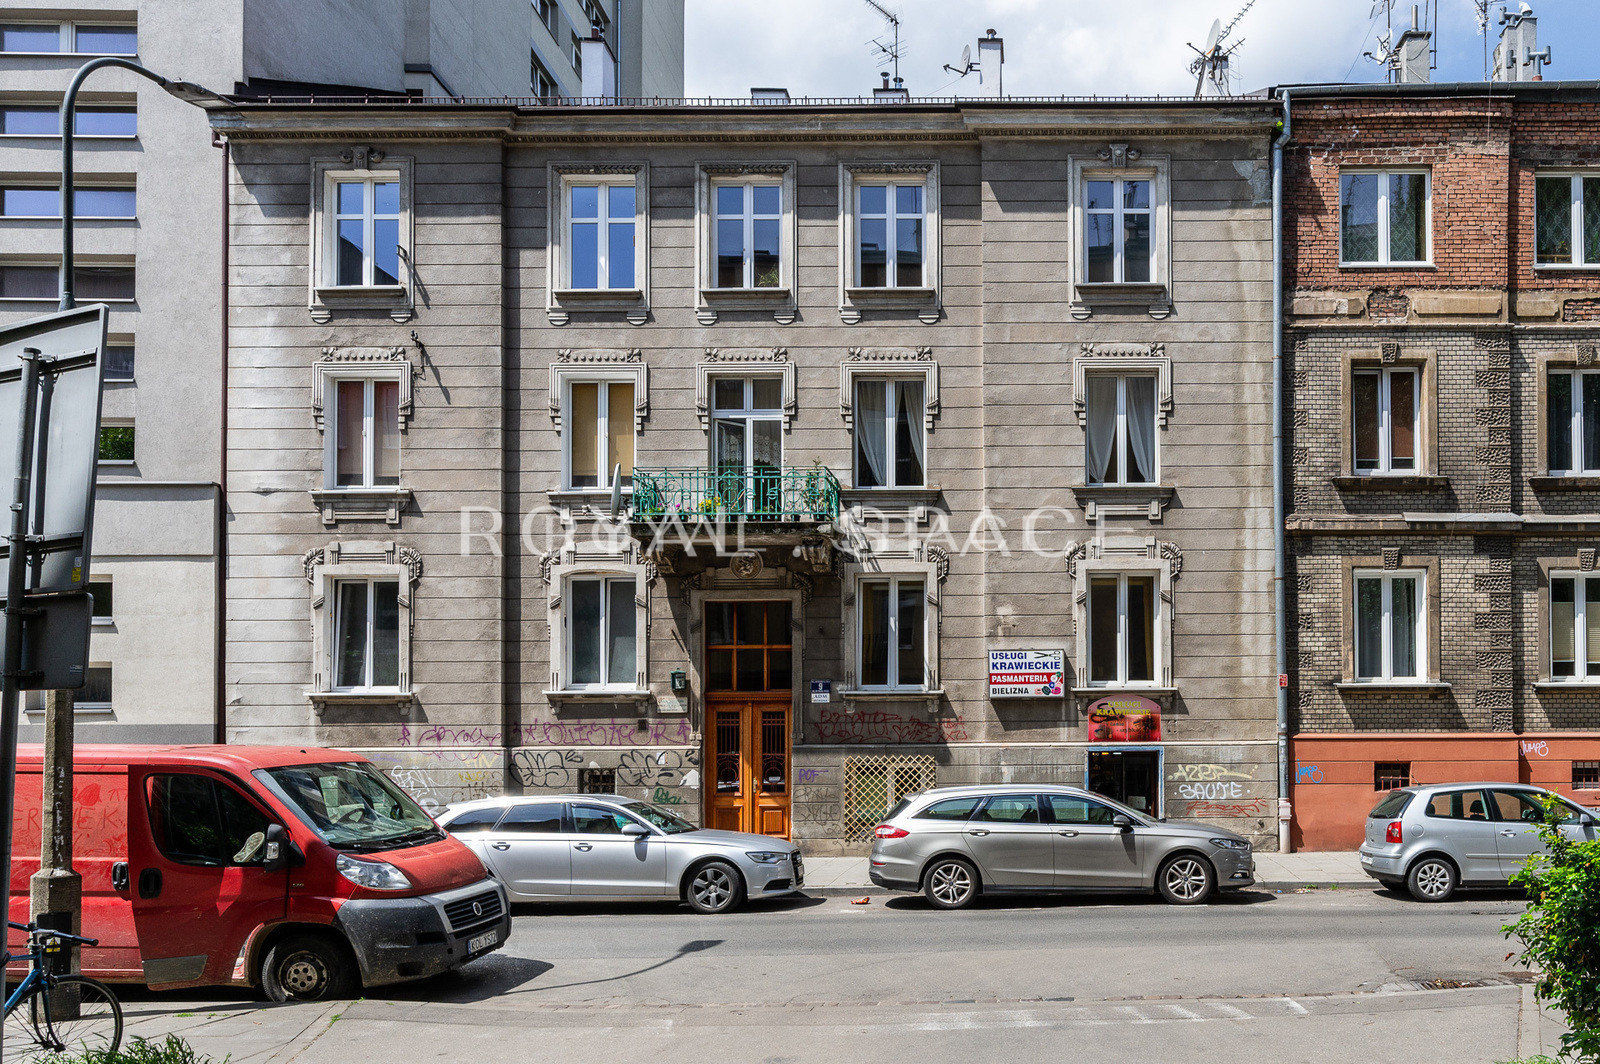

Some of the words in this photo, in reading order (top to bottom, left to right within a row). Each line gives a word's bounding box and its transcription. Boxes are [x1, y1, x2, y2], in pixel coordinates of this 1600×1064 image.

[991, 652, 1027, 660] USŁUGI
[991, 661, 1061, 670] KRAWIECKIE
[991, 675, 1049, 683] PASMANTERIA
[818, 682, 824, 691] 9
[991, 687, 1030, 695] BIELIZNA
[1096, 708, 1151, 716] KRAWIECKIE
